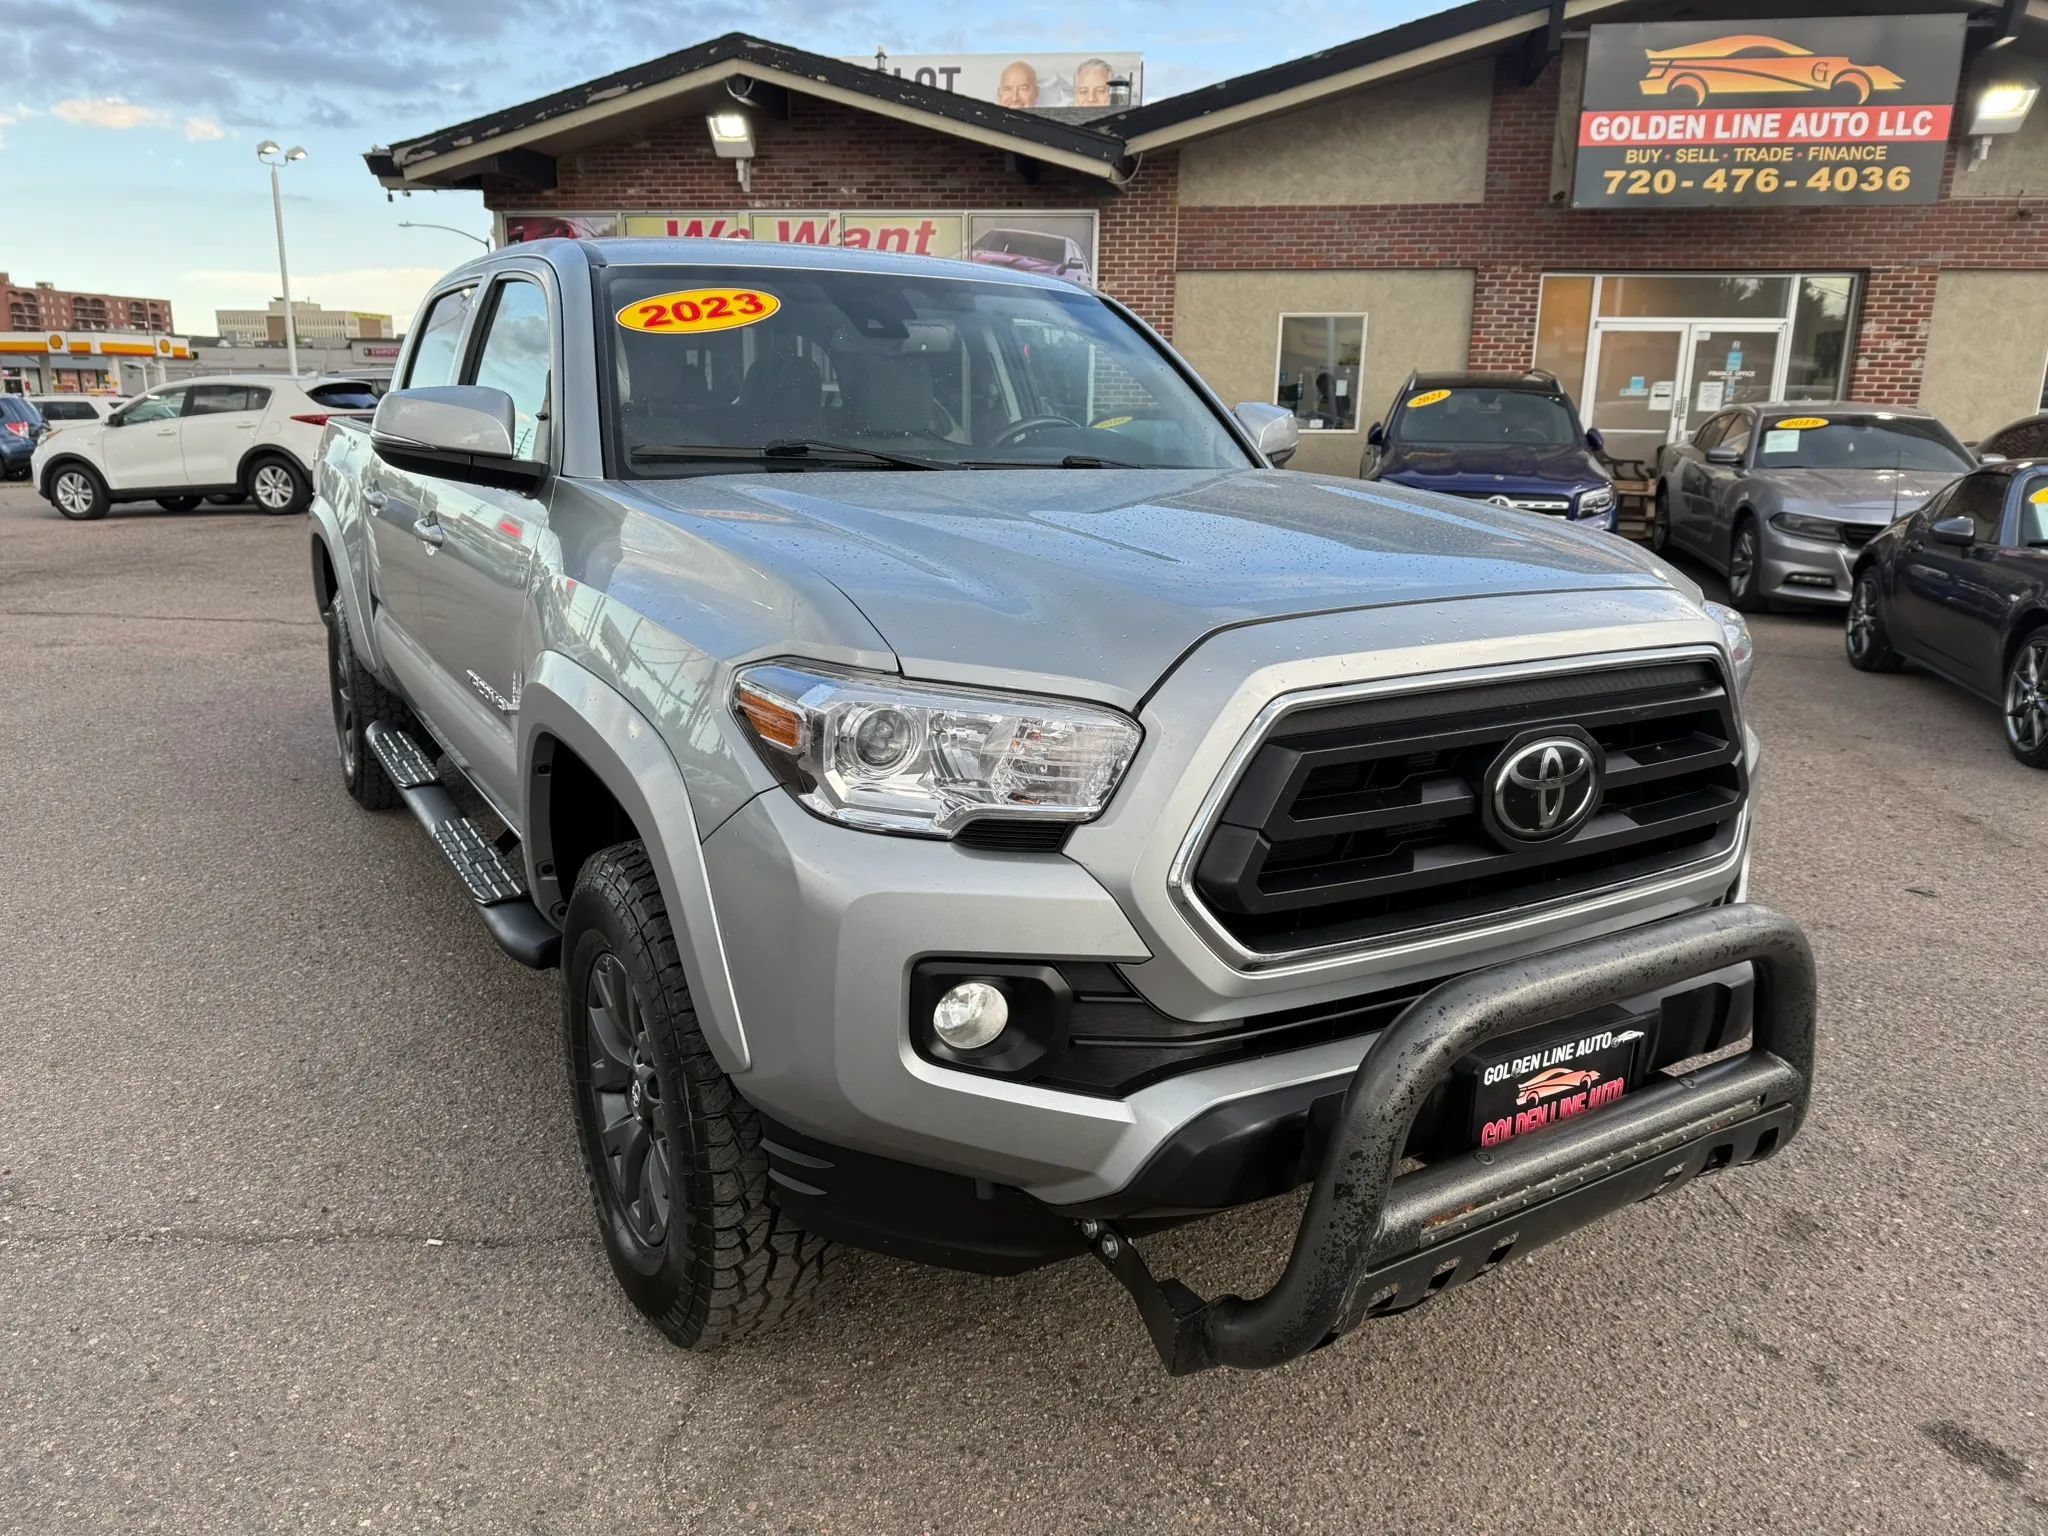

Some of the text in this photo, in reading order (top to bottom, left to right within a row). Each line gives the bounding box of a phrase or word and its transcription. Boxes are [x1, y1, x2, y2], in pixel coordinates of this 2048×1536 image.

[1590, 110, 1934, 141] GOLDEN LINE AUTO LLC
[1625, 145, 1889, 164] BUY SELL TRADE FINANCE
[638, 292, 765, 328] 2023
[1483, 1031, 1612, 1086] GOLDEN LINE AUTO
